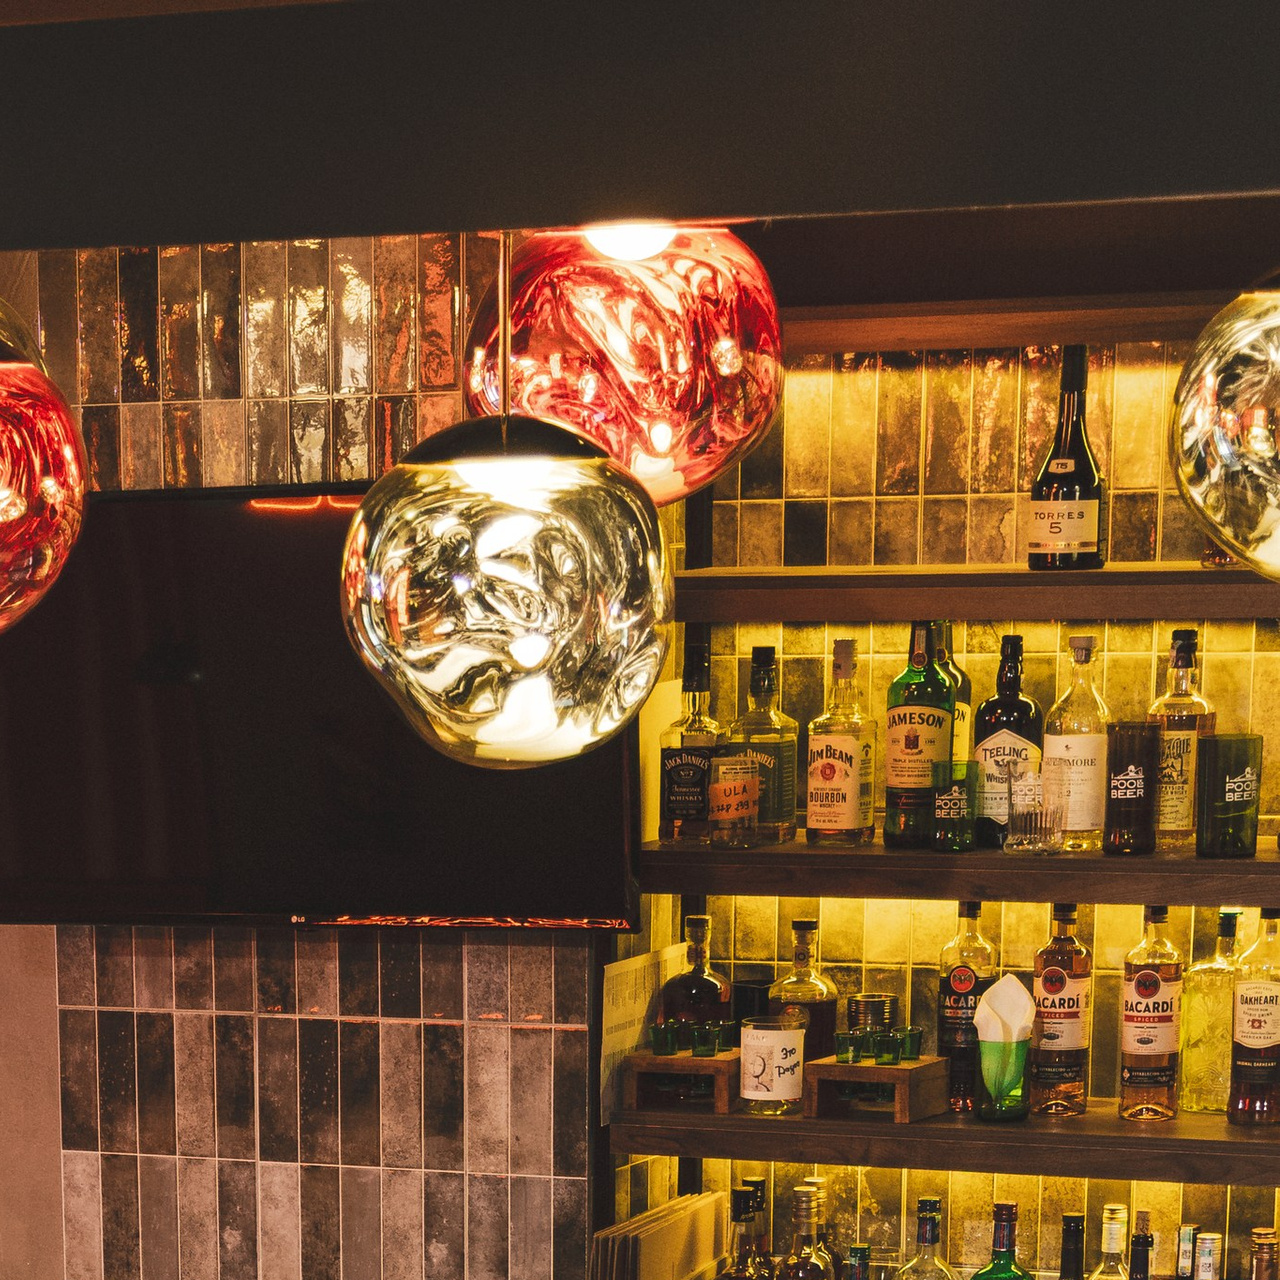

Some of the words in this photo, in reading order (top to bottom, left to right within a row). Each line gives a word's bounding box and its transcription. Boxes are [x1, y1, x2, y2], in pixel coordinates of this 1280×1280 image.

[1034, 511, 1085, 520] TORRES
[1049, 522, 1062, 534] 5
[887, 712, 945, 729] JAMESON
[808, 749, 824, 768] JIM
[825, 744, 854, 768] BEAM
[982, 746, 1028, 761] TEELING
[723, 784, 748, 797] ULA
[1110, 790, 1145, 799] BEER
[1225, 791, 1258, 802] BEER
[809, 792, 847, 803] BOURBON
[1011, 795, 1043, 804] BEER
[935, 810, 967, 818] BEER
[1035, 993, 1080, 1009] ACARDÍ
[1124, 998, 1173, 1013] BACARDÍ
[1240, 994, 1279, 1006] OAKHEART
[781, 1047, 797, 1060] Это
